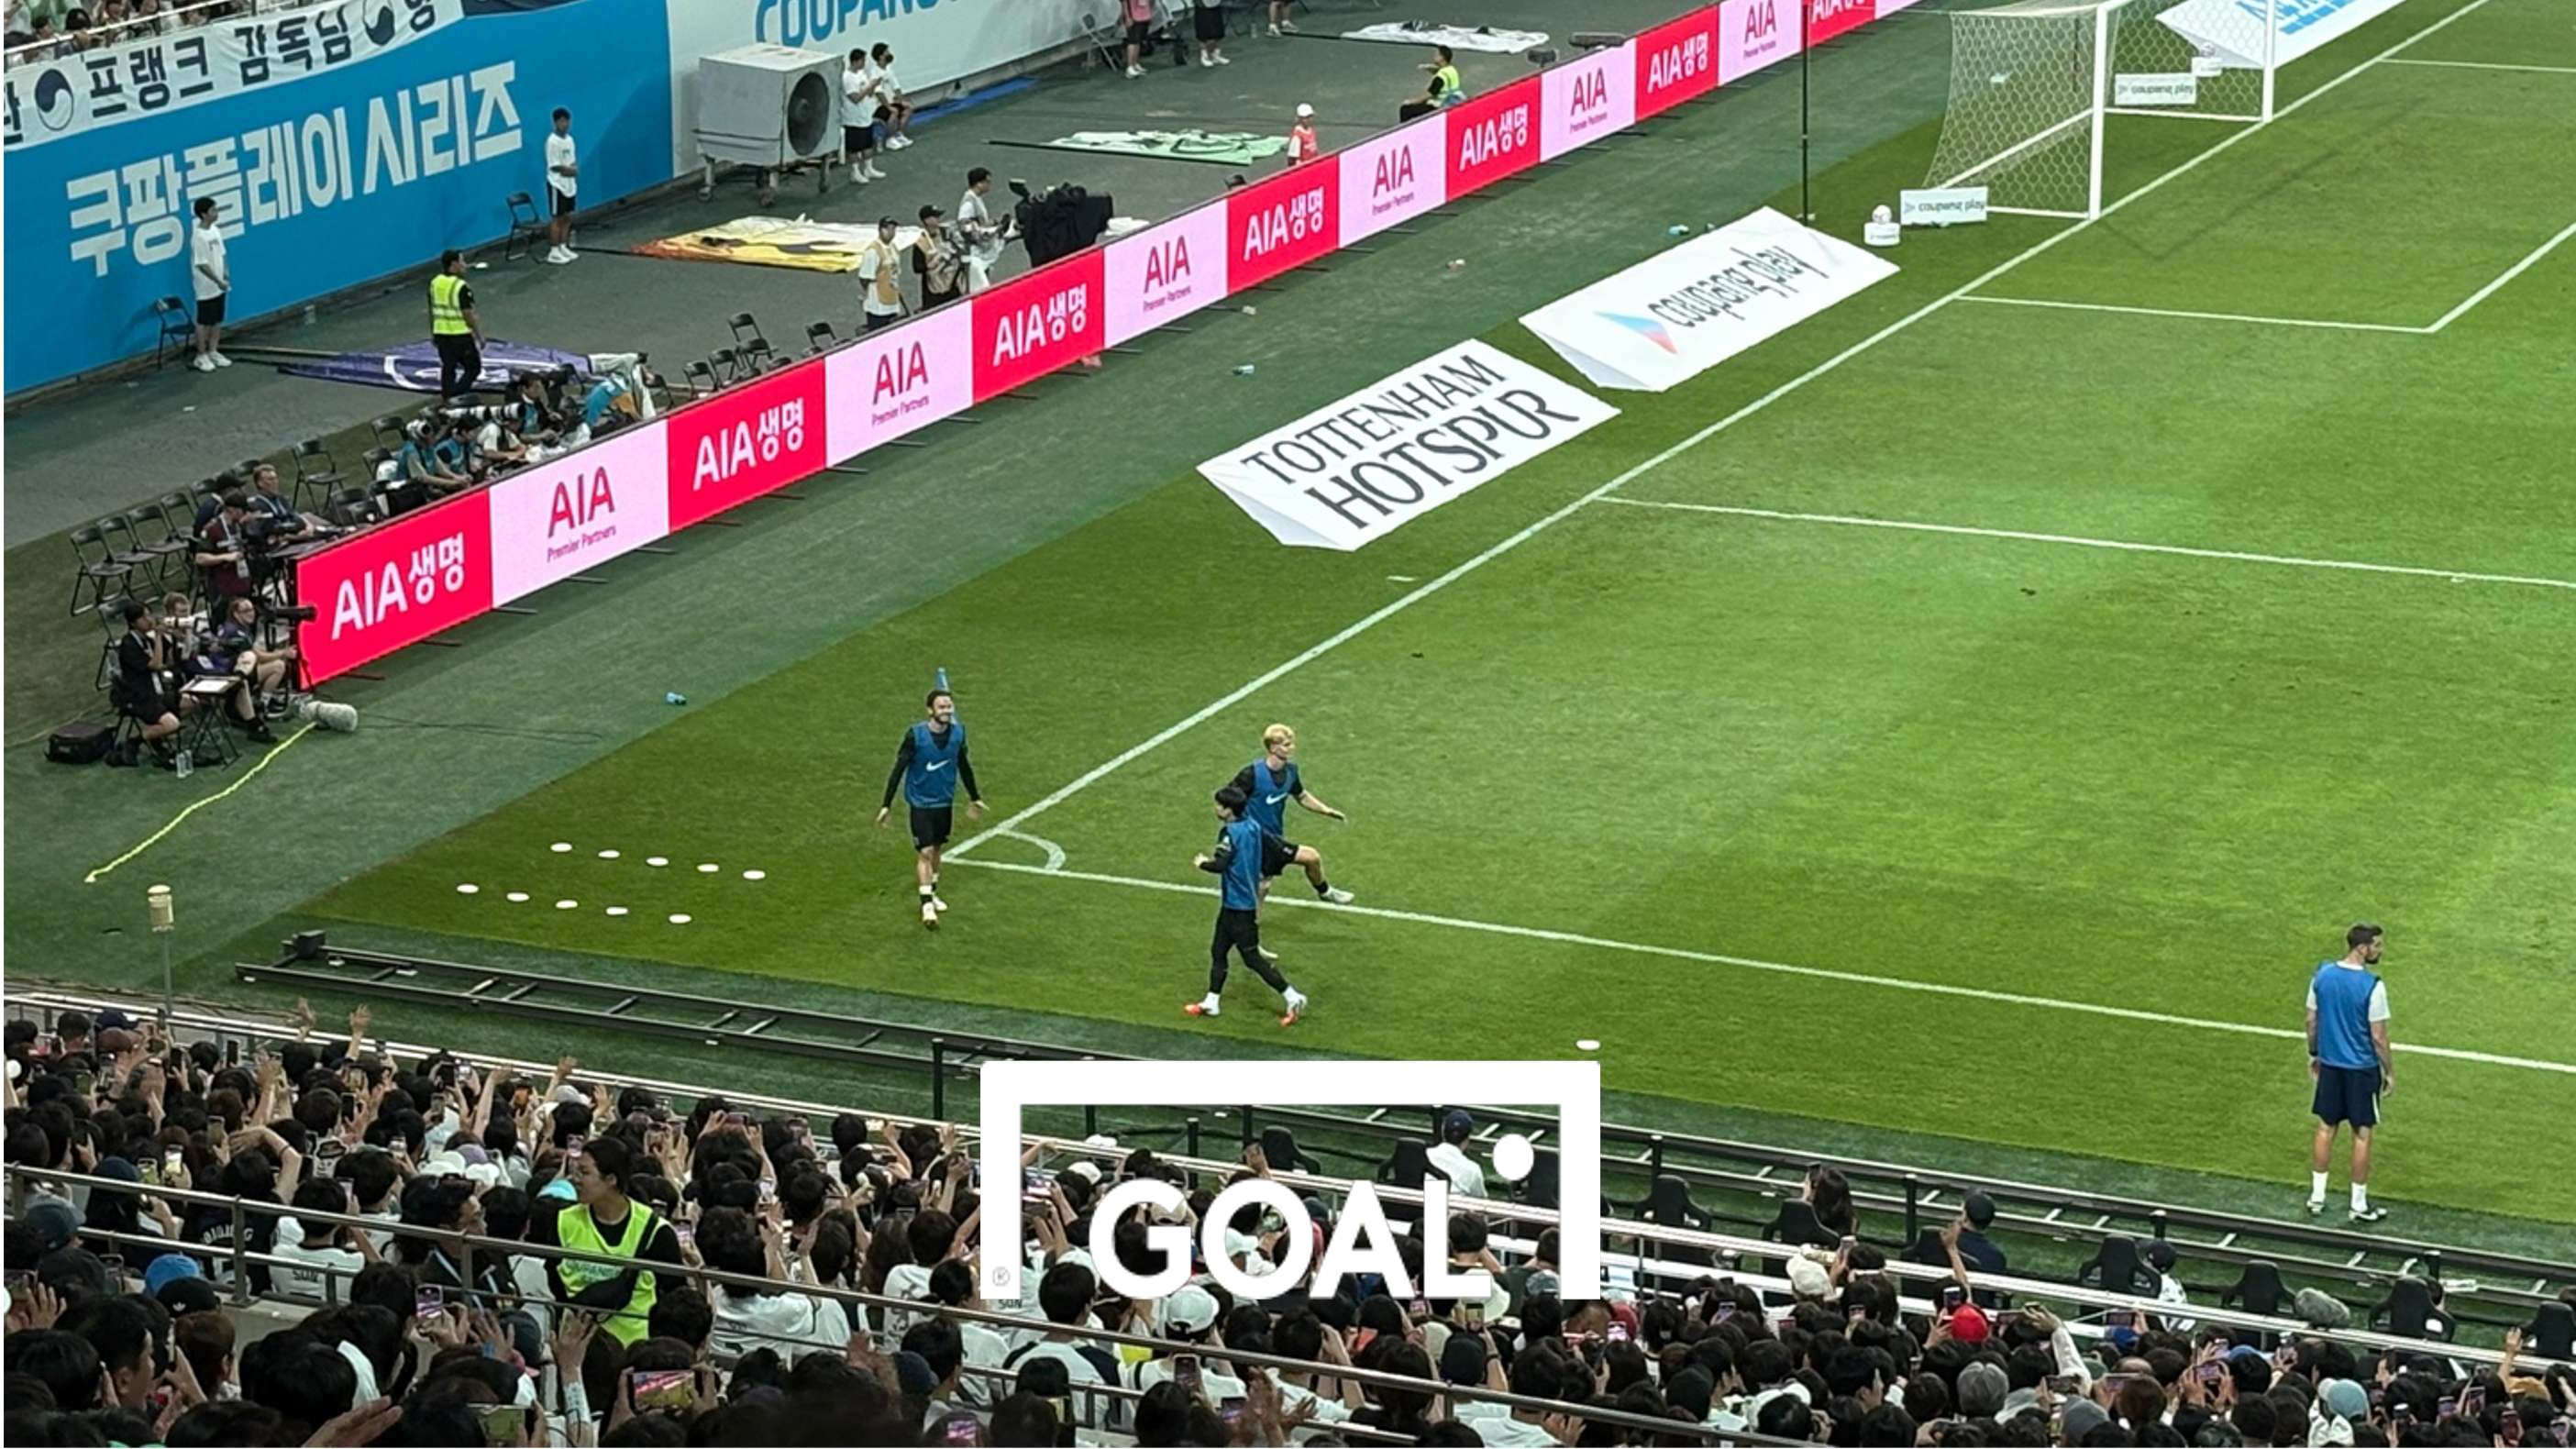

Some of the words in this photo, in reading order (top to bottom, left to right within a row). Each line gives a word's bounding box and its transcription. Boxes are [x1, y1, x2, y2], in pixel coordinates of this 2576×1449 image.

[1744, 0, 1776, 44] AIA
[85, 36, 214, 118] 프랭크
[235, 4, 352, 86] 감독님
[1570, 67, 1608, 116] AIA
[66, 106, 353, 278] 쿠팡플레이
[362, 60, 523, 195] 시리즈
[1373, 144, 1414, 198] AIA
[1144, 235, 1191, 293] AIA
[872, 340, 929, 406] AIA
[1240, 354, 1507, 484] TOTTENHAM
[1303, 389, 1580, 530] HOTSPUR
[547, 466, 615, 539] AIA
